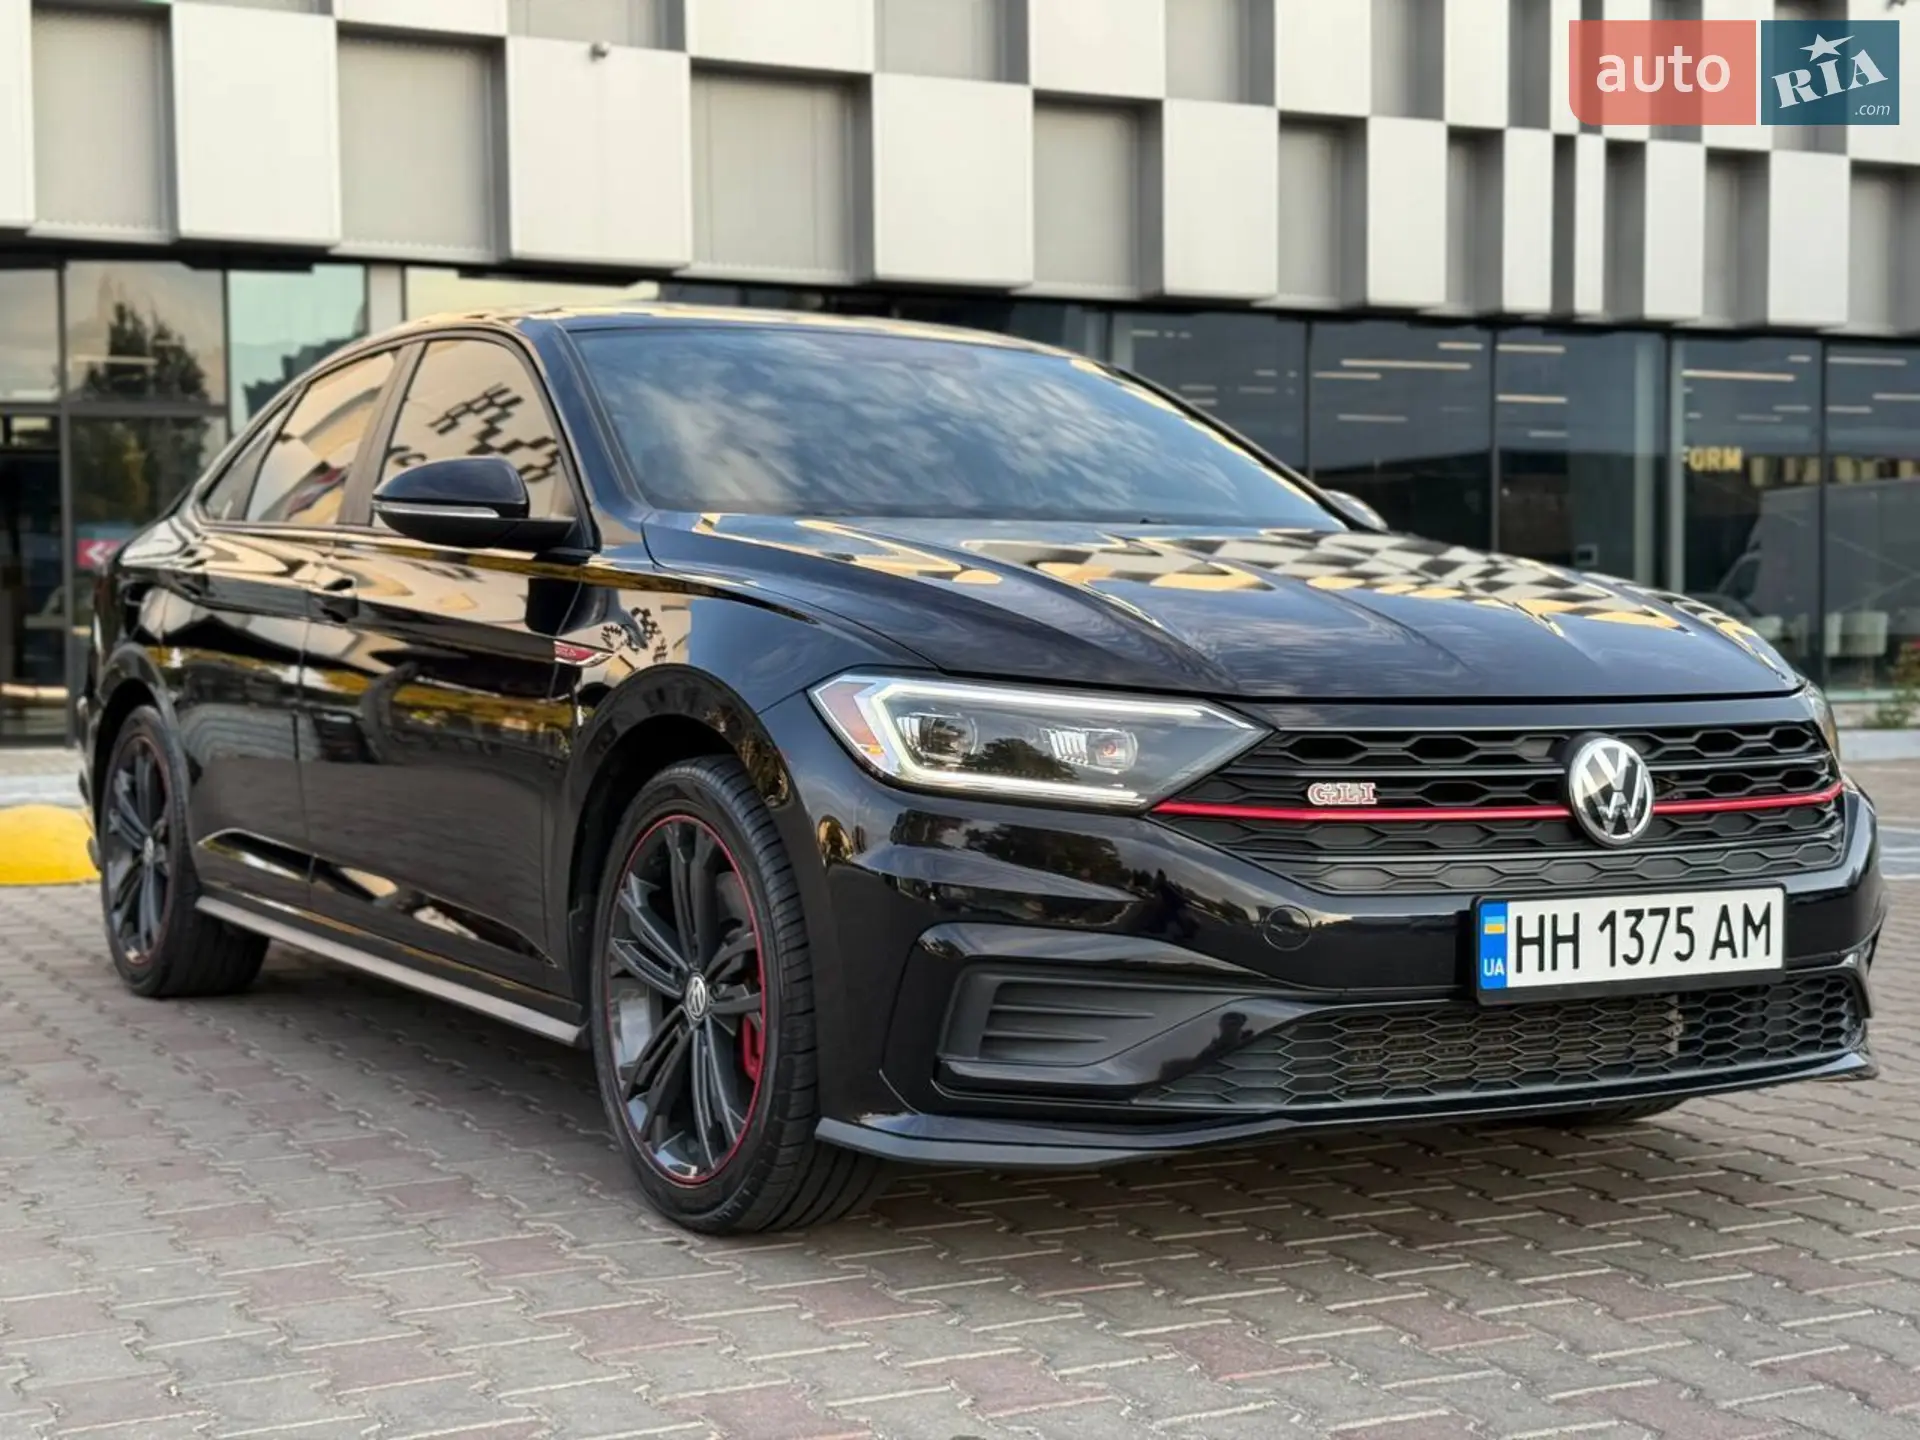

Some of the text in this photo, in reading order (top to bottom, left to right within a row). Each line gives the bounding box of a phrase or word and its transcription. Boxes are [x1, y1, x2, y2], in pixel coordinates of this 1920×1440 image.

[1307, 782, 1378, 805] GLI
[1515, 901, 1771, 973] HH 1375 AM
[1483, 958, 1505, 977] UA
